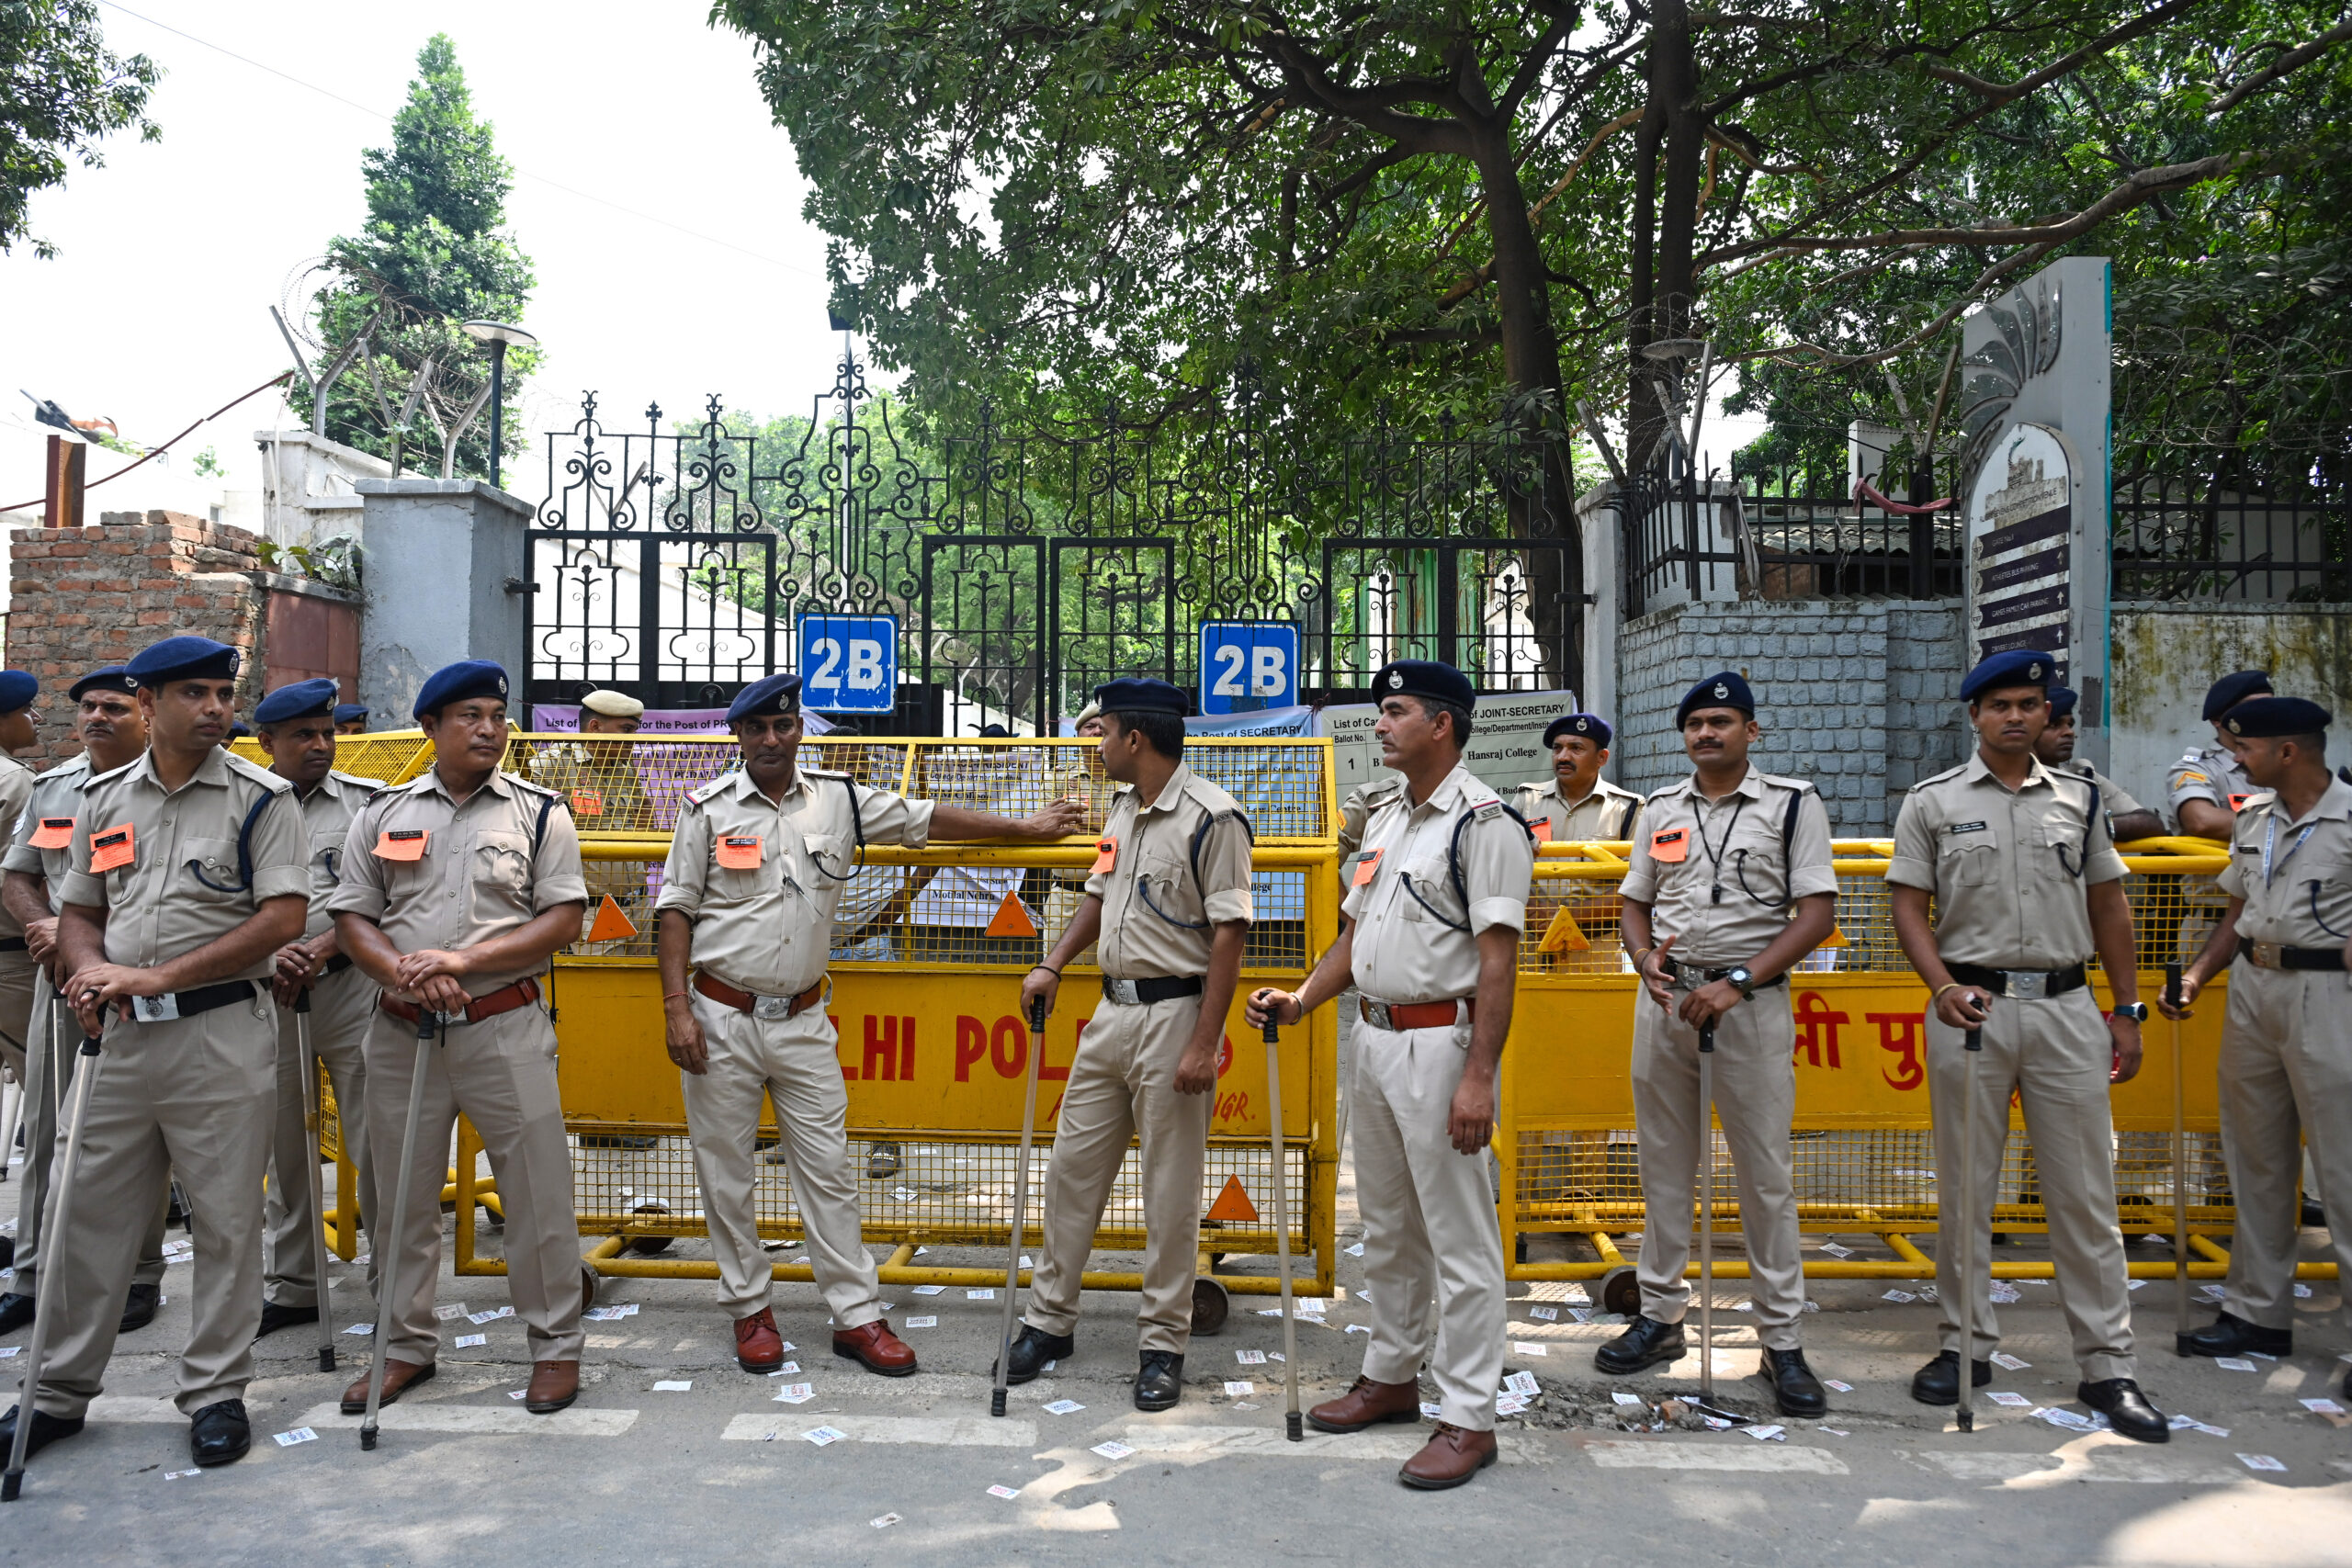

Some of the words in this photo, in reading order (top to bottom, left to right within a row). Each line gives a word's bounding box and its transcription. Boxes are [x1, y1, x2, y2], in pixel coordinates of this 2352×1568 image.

[2020, 603, 2030, 611] CAR
[2030, 597, 2049, 609] PARKING
[809, 637, 883, 690] 2B
[1213, 645, 1286, 696] 2B
[1480, 704, 1565, 719] JOINT-SECRETARY
[546, 718, 564, 728] List
[567, 718, 578, 728] of
[639, 720, 652, 729] for
[655, 720, 672, 729] the
[674, 721, 697, 729] Post
[700, 720, 710, 728] of
[1333, 719, 1351, 729] List
[1352, 717, 1362, 728] of
[1470, 720, 1550, 735] ollege/Department/Instit
[1240, 725, 1303, 738] SECRETARY
[1334, 734, 1353, 744] Ballot
[1354, 734, 1366, 742] No.
[1467, 749, 1503, 761] Hansraj
[1505, 747, 1538, 759] College
[1348, 758, 1354, 770] 1
[933, 890, 964, 900] Motilal
[967, 891, 995, 900] Nehru
[828, 1014, 916, 1082] LHI
